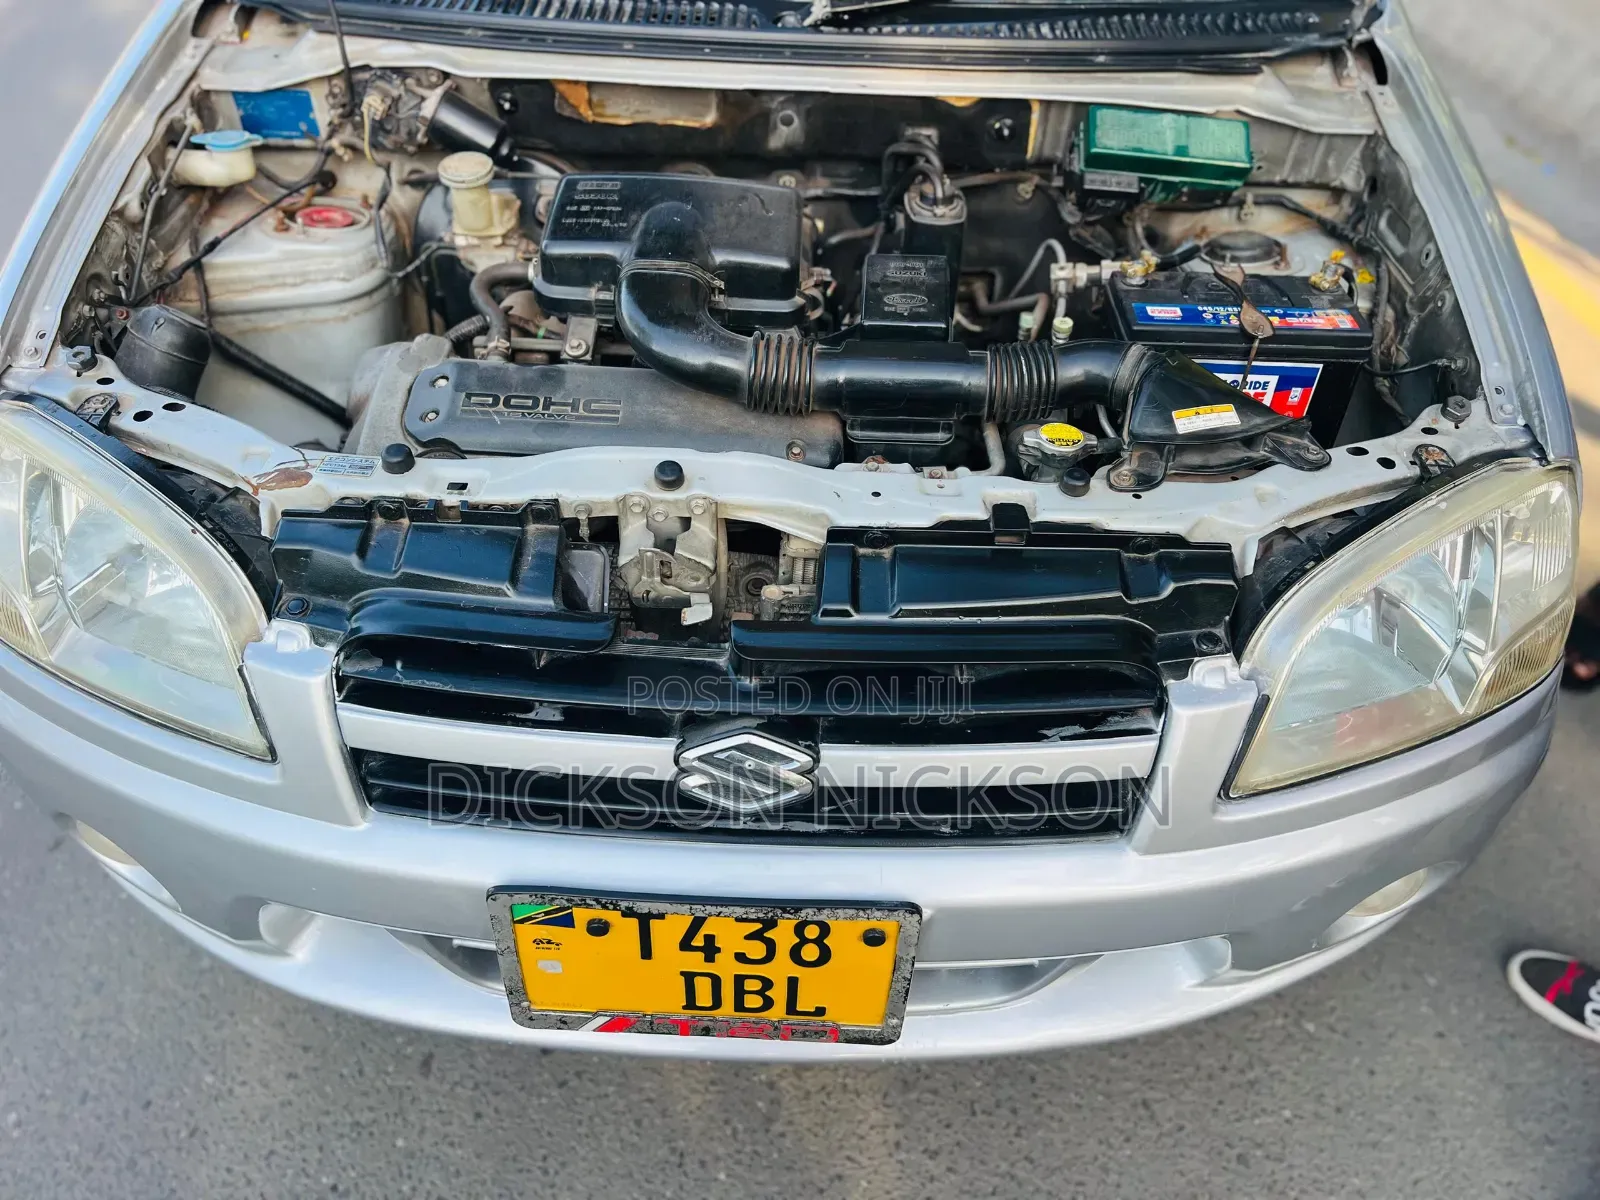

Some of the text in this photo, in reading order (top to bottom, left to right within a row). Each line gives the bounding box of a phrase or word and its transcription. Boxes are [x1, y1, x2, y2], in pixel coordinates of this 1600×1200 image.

[461, 392, 622, 416] DOHC
[621, 912, 832, 968] T438
[679, 970, 827, 1017] DBL
